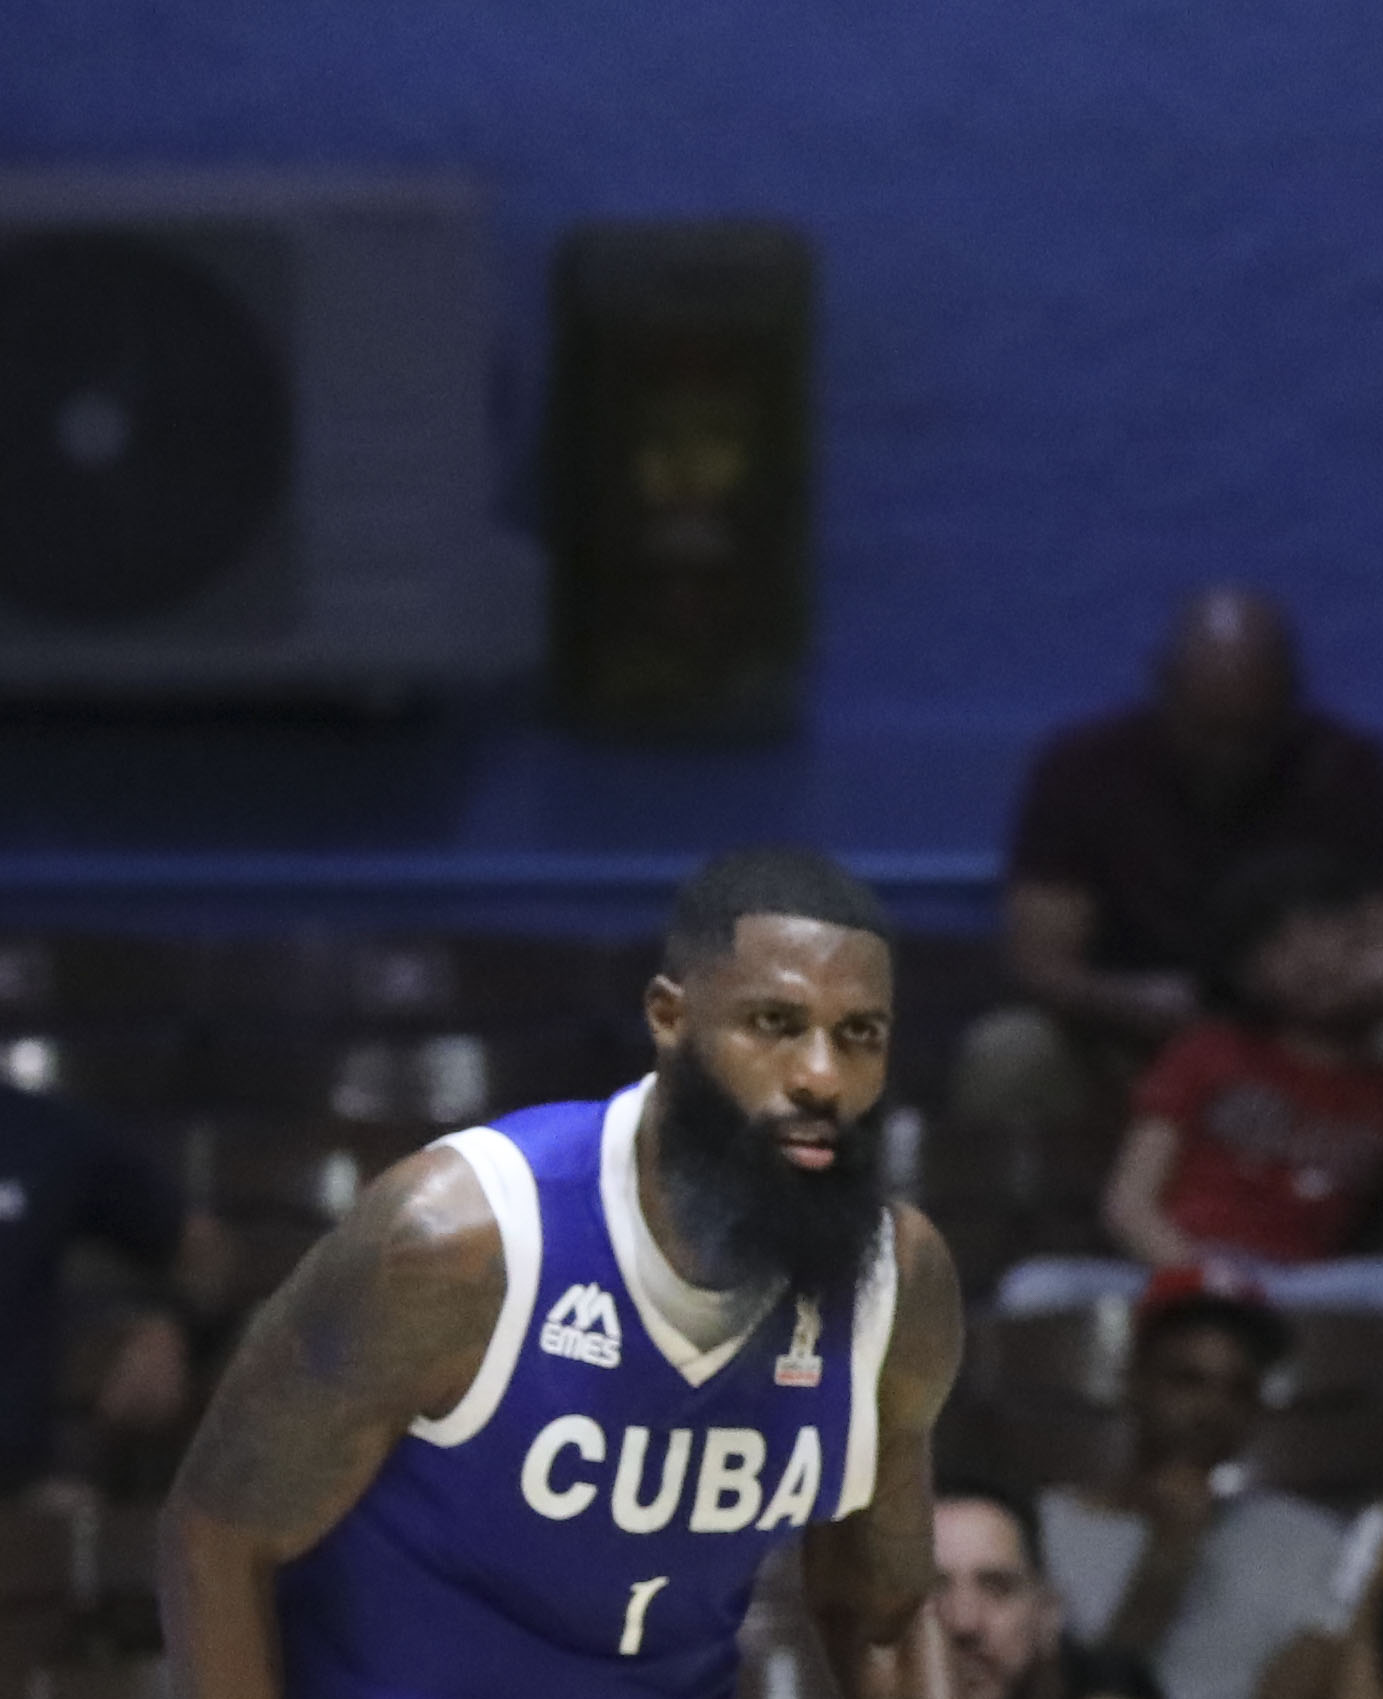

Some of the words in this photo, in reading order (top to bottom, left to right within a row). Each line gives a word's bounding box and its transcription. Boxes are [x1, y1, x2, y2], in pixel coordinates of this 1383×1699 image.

[539, 1324, 621, 1369] EMES
[520, 1413, 821, 1535] CUBA
[618, 1575, 670, 1656] 1
